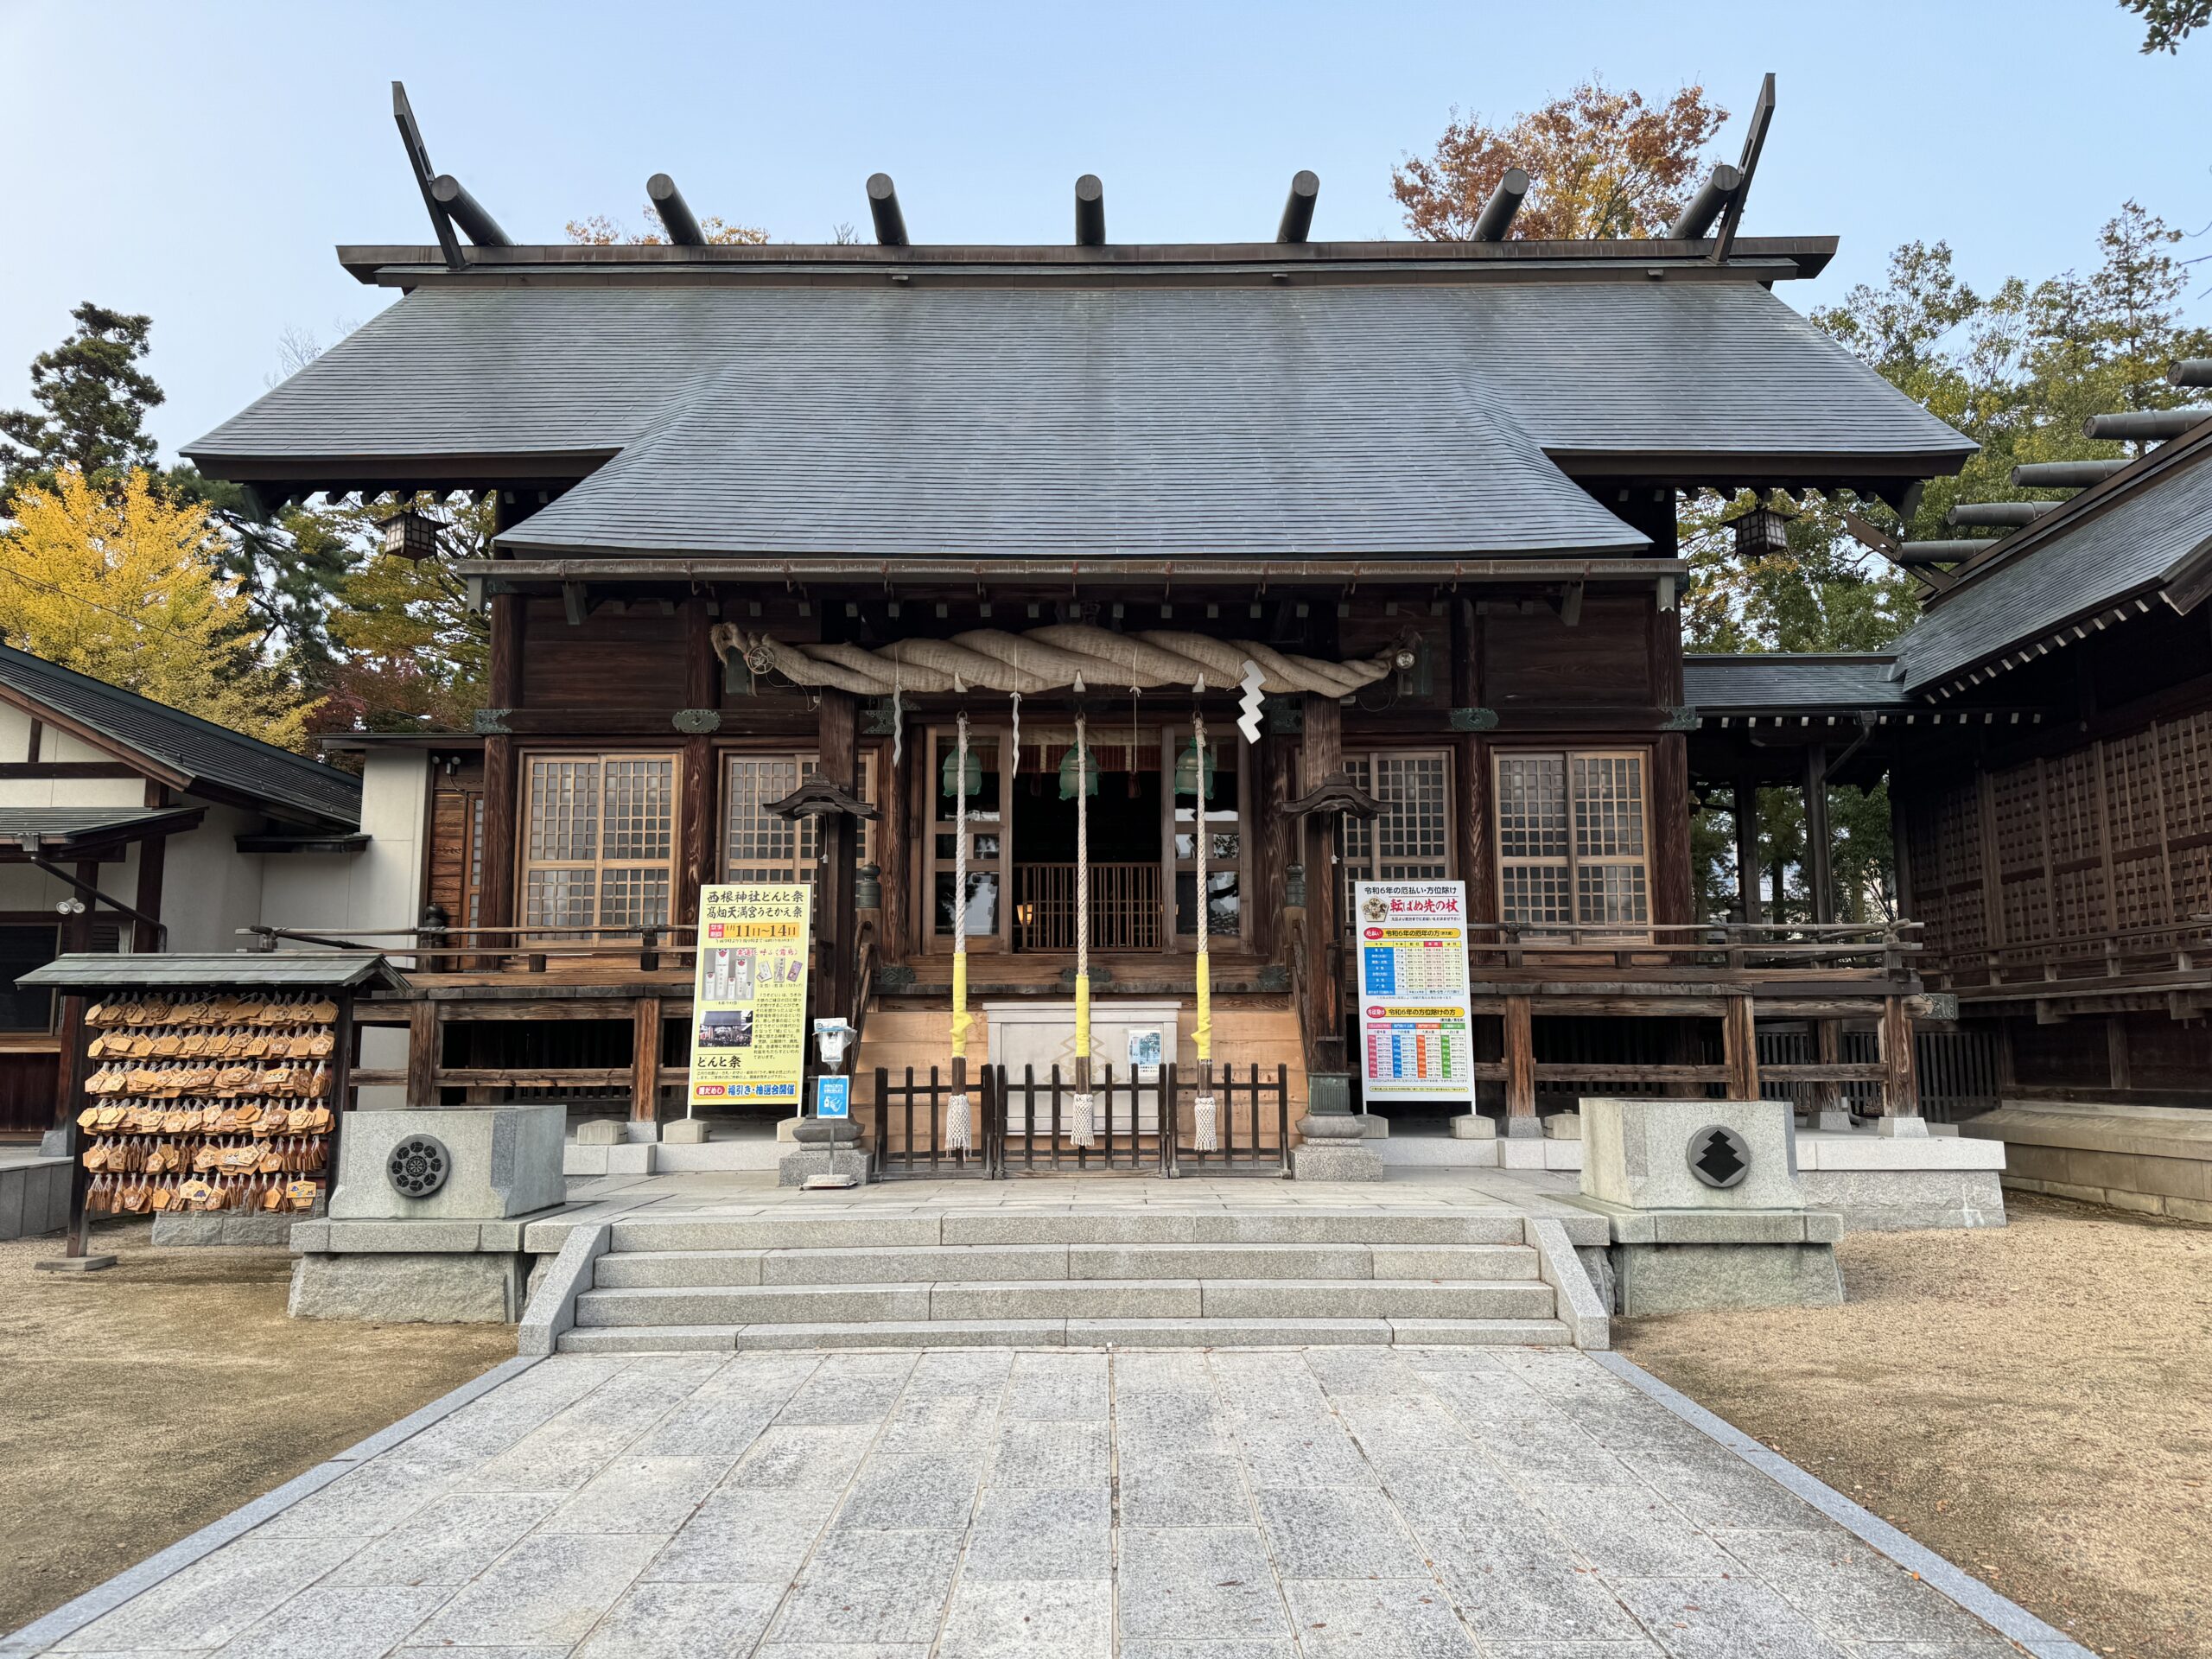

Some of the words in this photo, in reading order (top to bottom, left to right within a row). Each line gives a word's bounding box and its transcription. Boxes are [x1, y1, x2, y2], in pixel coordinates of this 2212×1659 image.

[707, 890, 804, 903] 西根神社どんと祭
[1389, 898, 1459, 912] 転ばぬ先の杖
[697, 1055, 741, 1068] どんと祭
